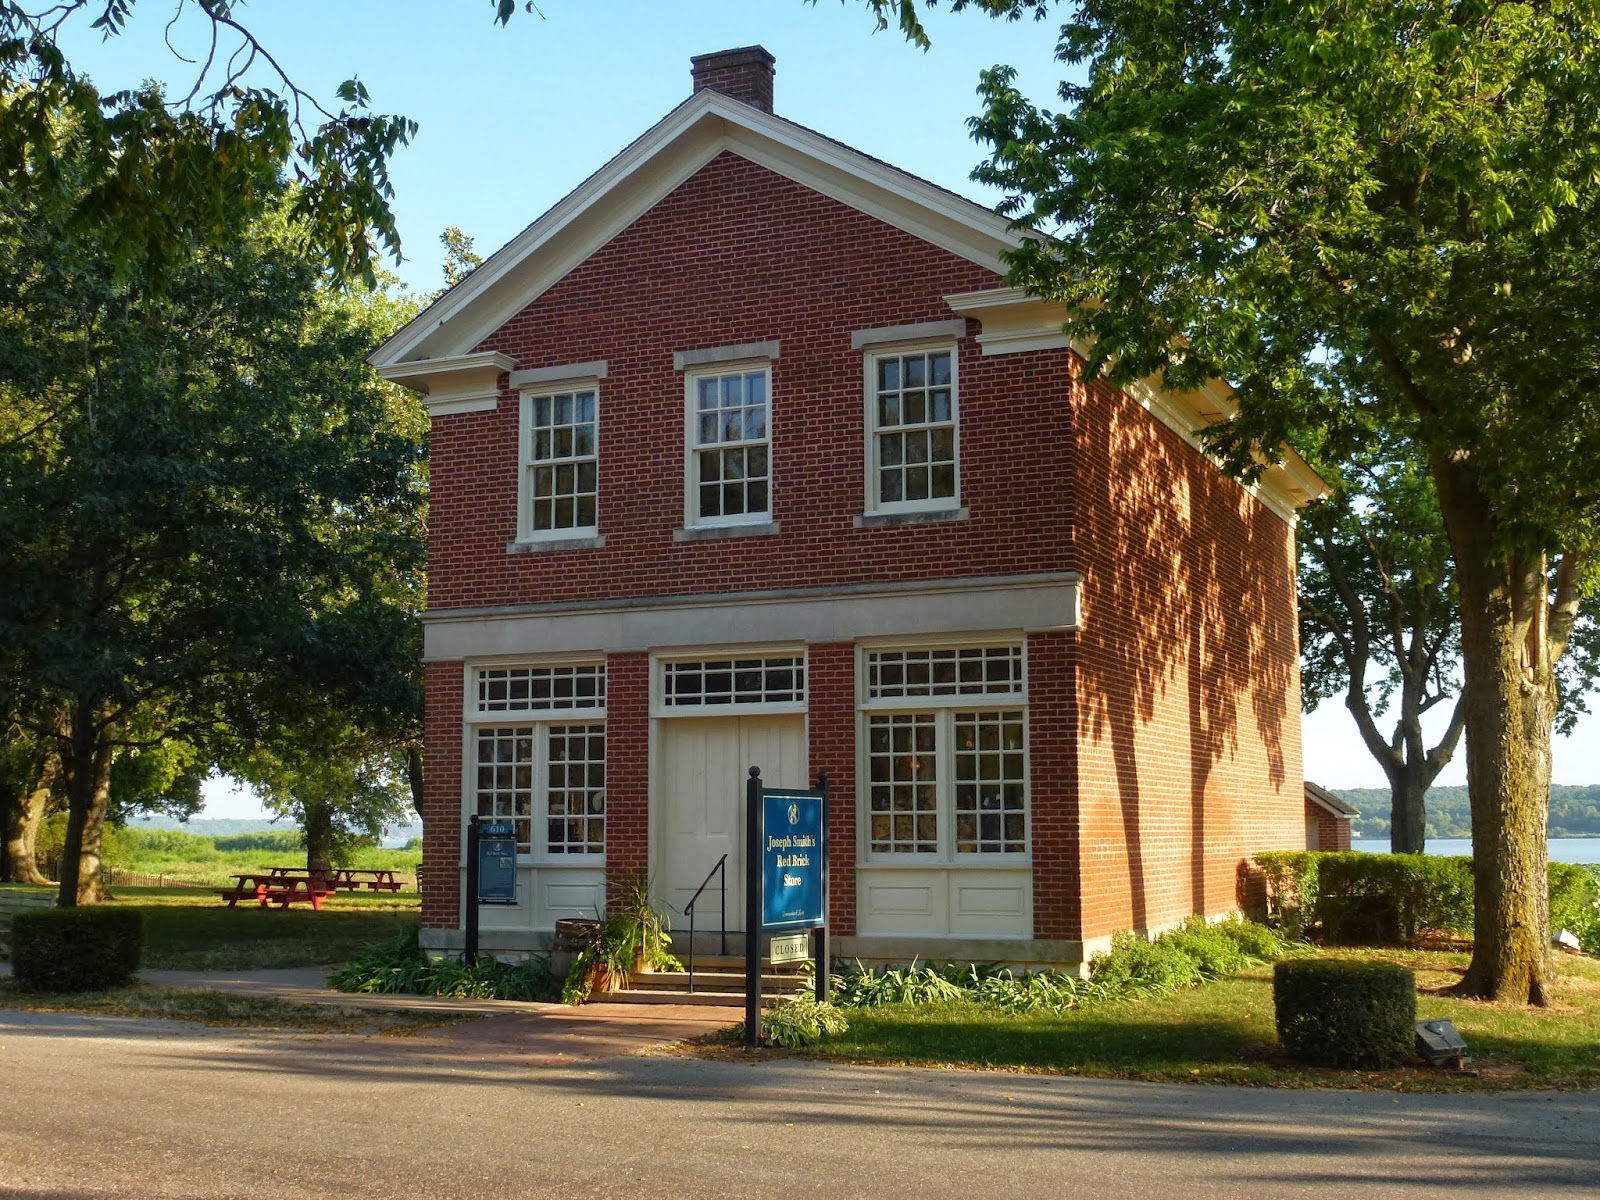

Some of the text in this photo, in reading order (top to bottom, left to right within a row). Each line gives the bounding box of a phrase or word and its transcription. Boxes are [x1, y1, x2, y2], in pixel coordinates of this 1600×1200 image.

[767, 835, 815, 851] Joseph Smith's
[777, 854, 809, 867] Red Brick
[784, 874, 801, 886] Store
[775, 943, 804, 955] CLOSED
